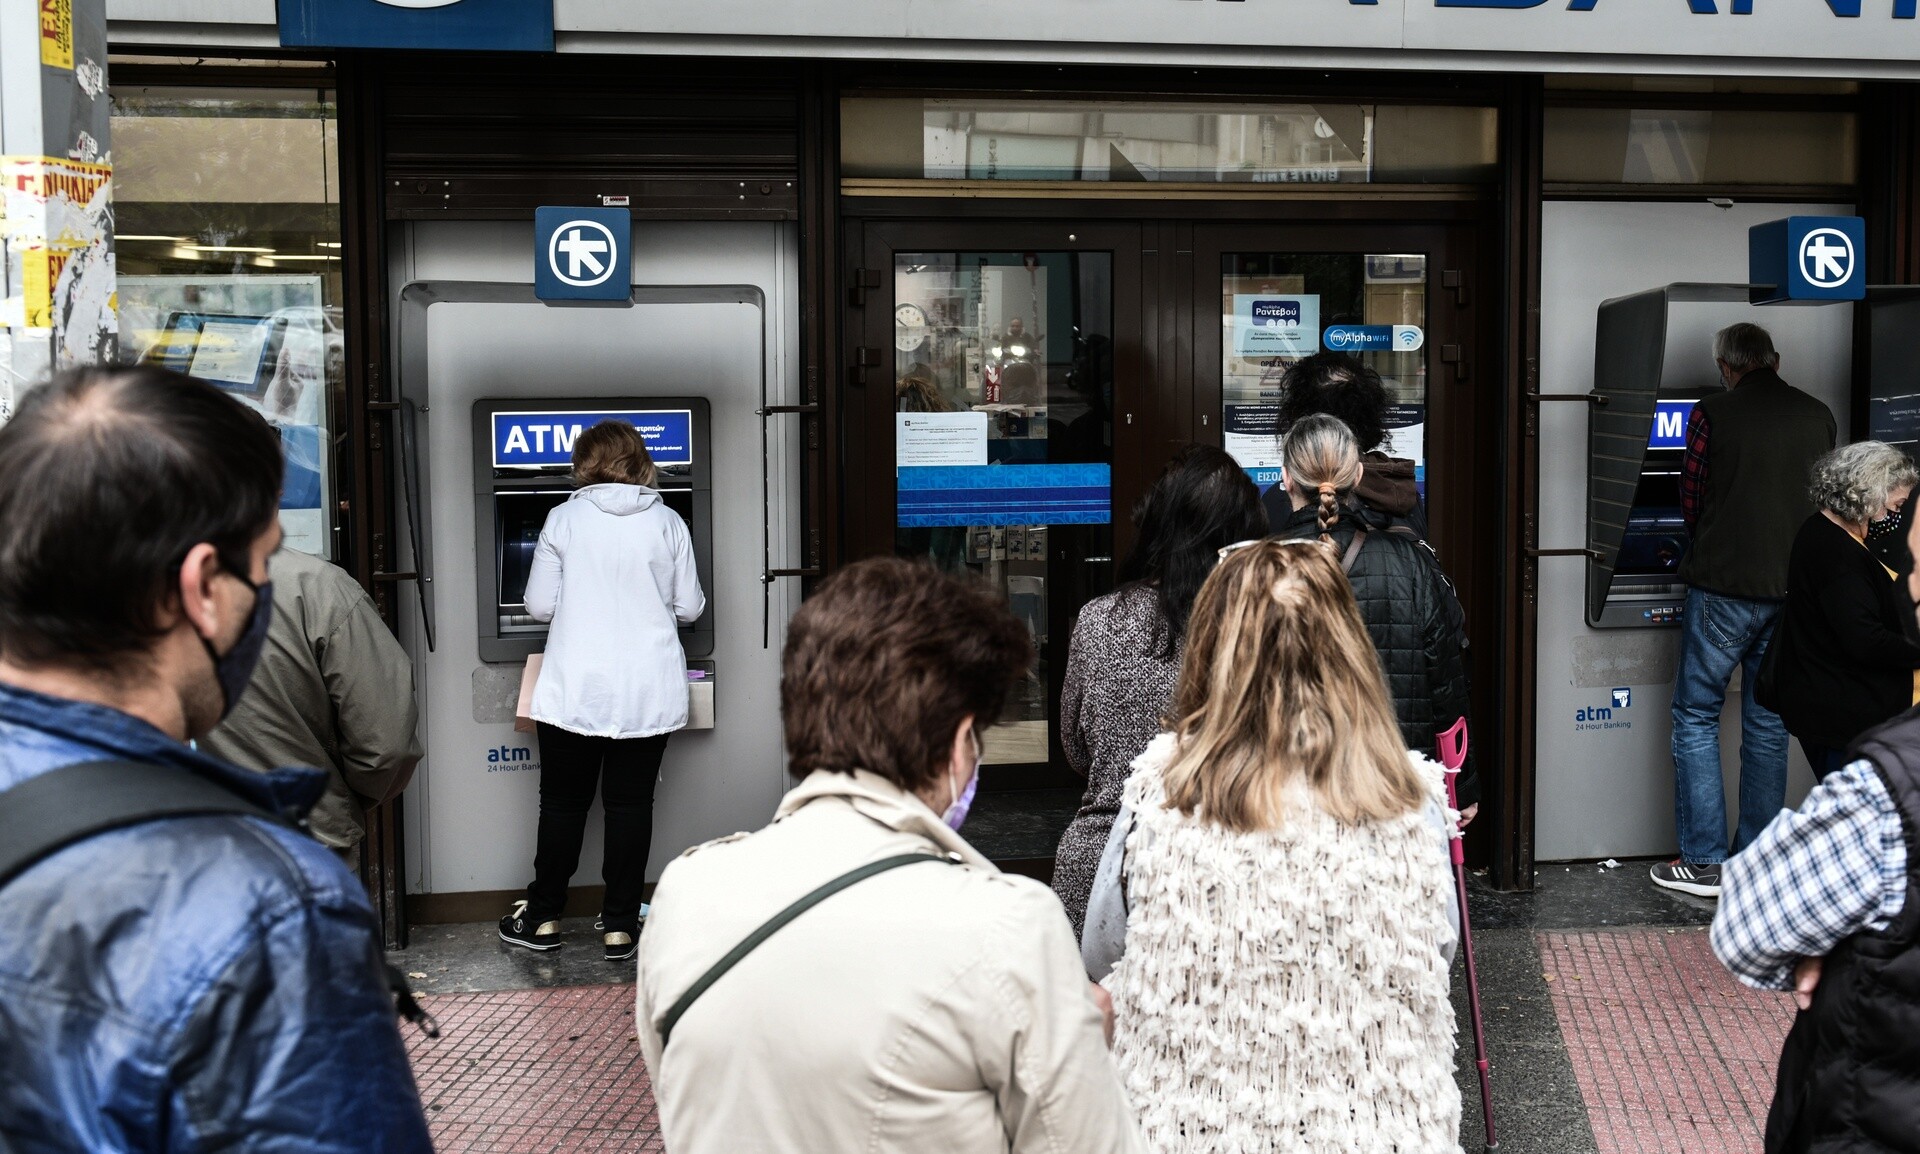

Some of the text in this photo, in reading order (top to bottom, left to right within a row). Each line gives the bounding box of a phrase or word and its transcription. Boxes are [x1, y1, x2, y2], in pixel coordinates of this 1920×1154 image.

[1256, 307, 1297, 317] Ραντεβού
[1333, 331, 1372, 343] myAlpha
[503, 424, 583, 454] ATM
[1576, 706, 1611, 721] atm
[1575, 723, 1584, 731] 24
[1604, 721, 1632, 730] Banking
[488, 745, 531, 762] atm
